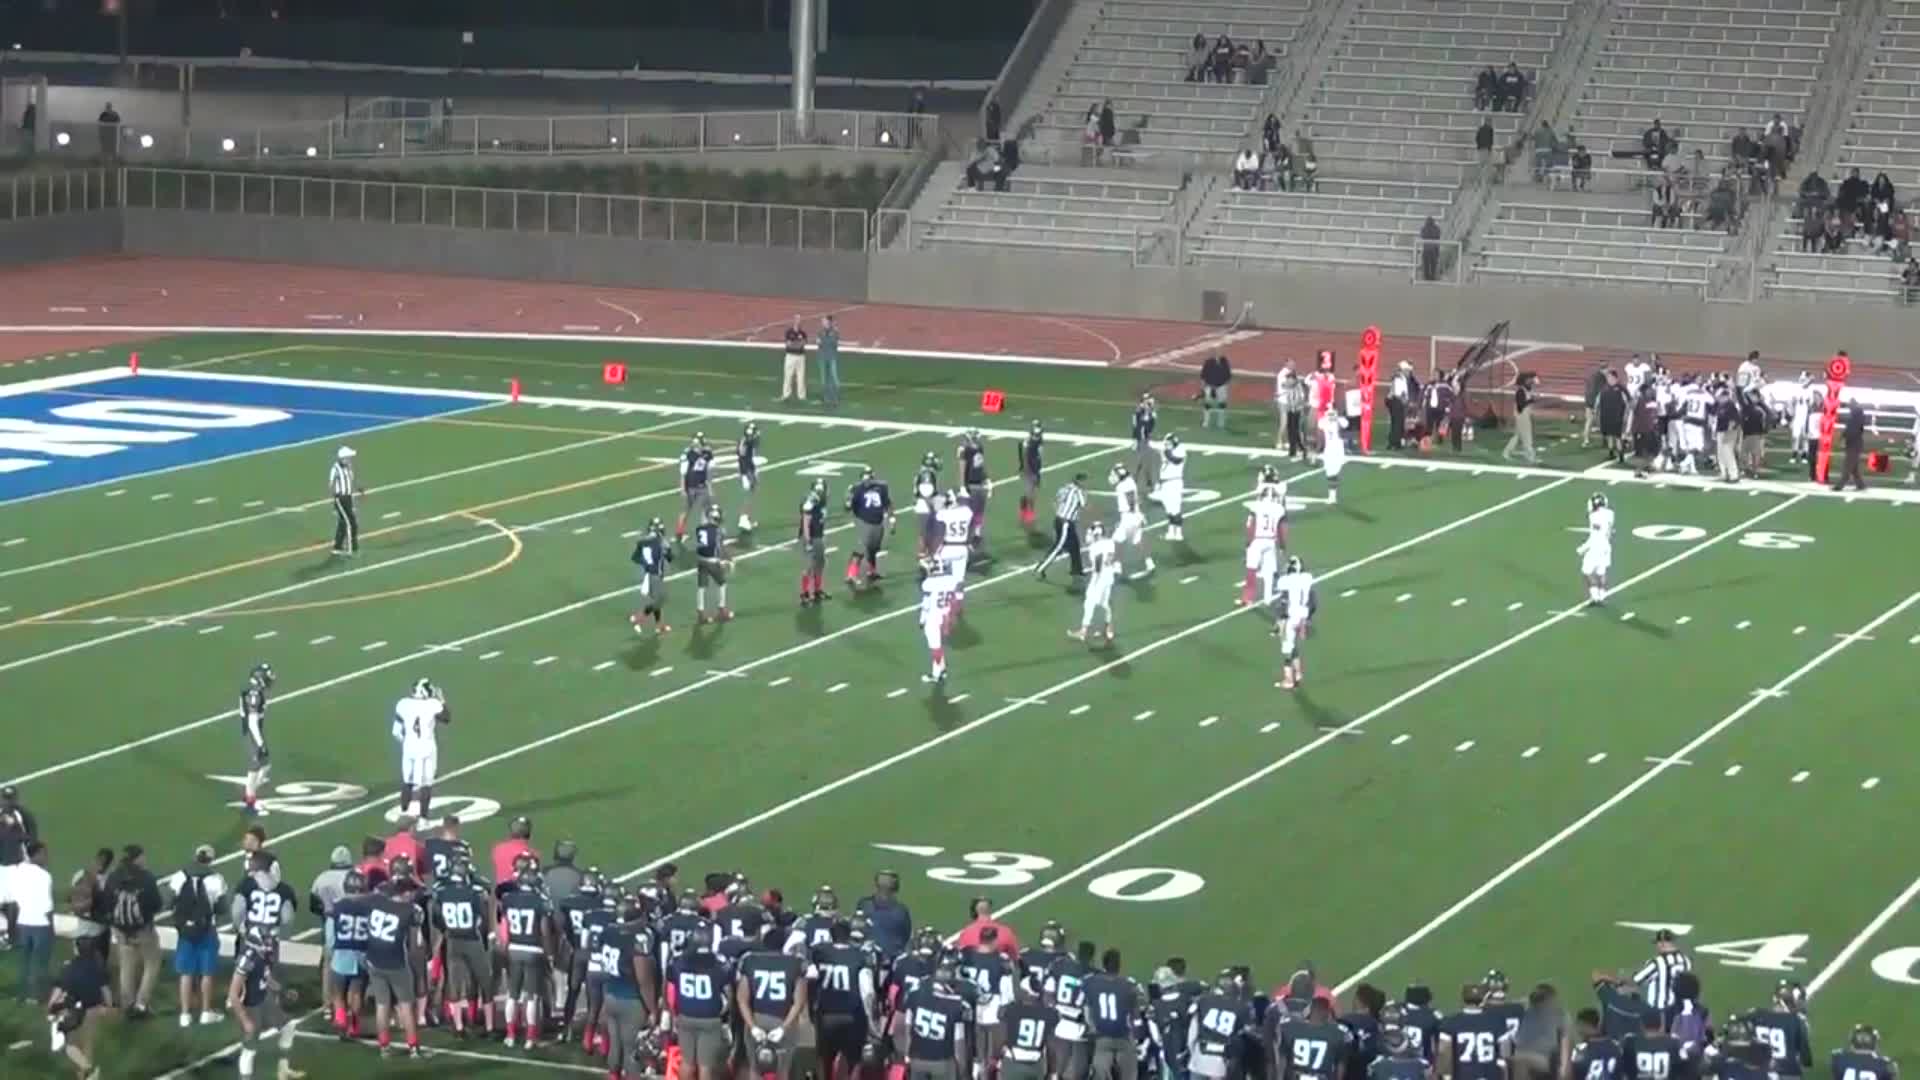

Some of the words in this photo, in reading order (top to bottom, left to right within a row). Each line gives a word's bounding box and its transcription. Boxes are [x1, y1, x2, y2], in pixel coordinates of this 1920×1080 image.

[949, 521, 967, 537] 55
[412, 714, 422, 739] 4
[248, 893, 281, 924] 32
[441, 902, 474, 928] 80
[507, 909, 535, 935] 87
[368, 909, 399, 942] 92
[679, 972, 712, 999] 60
[754, 969, 786, 1000] 75
[819, 963, 849, 992] 70
[1099, 992, 1117, 1020] 11
[916, 1007, 947, 1041] 55
[1017, 1018, 1045, 1048] 91
[1293, 1038, 1327, 1070] 97
[1457, 1032, 1495, 1062] 76
[1636, 1052, 1670, 1080] 90
